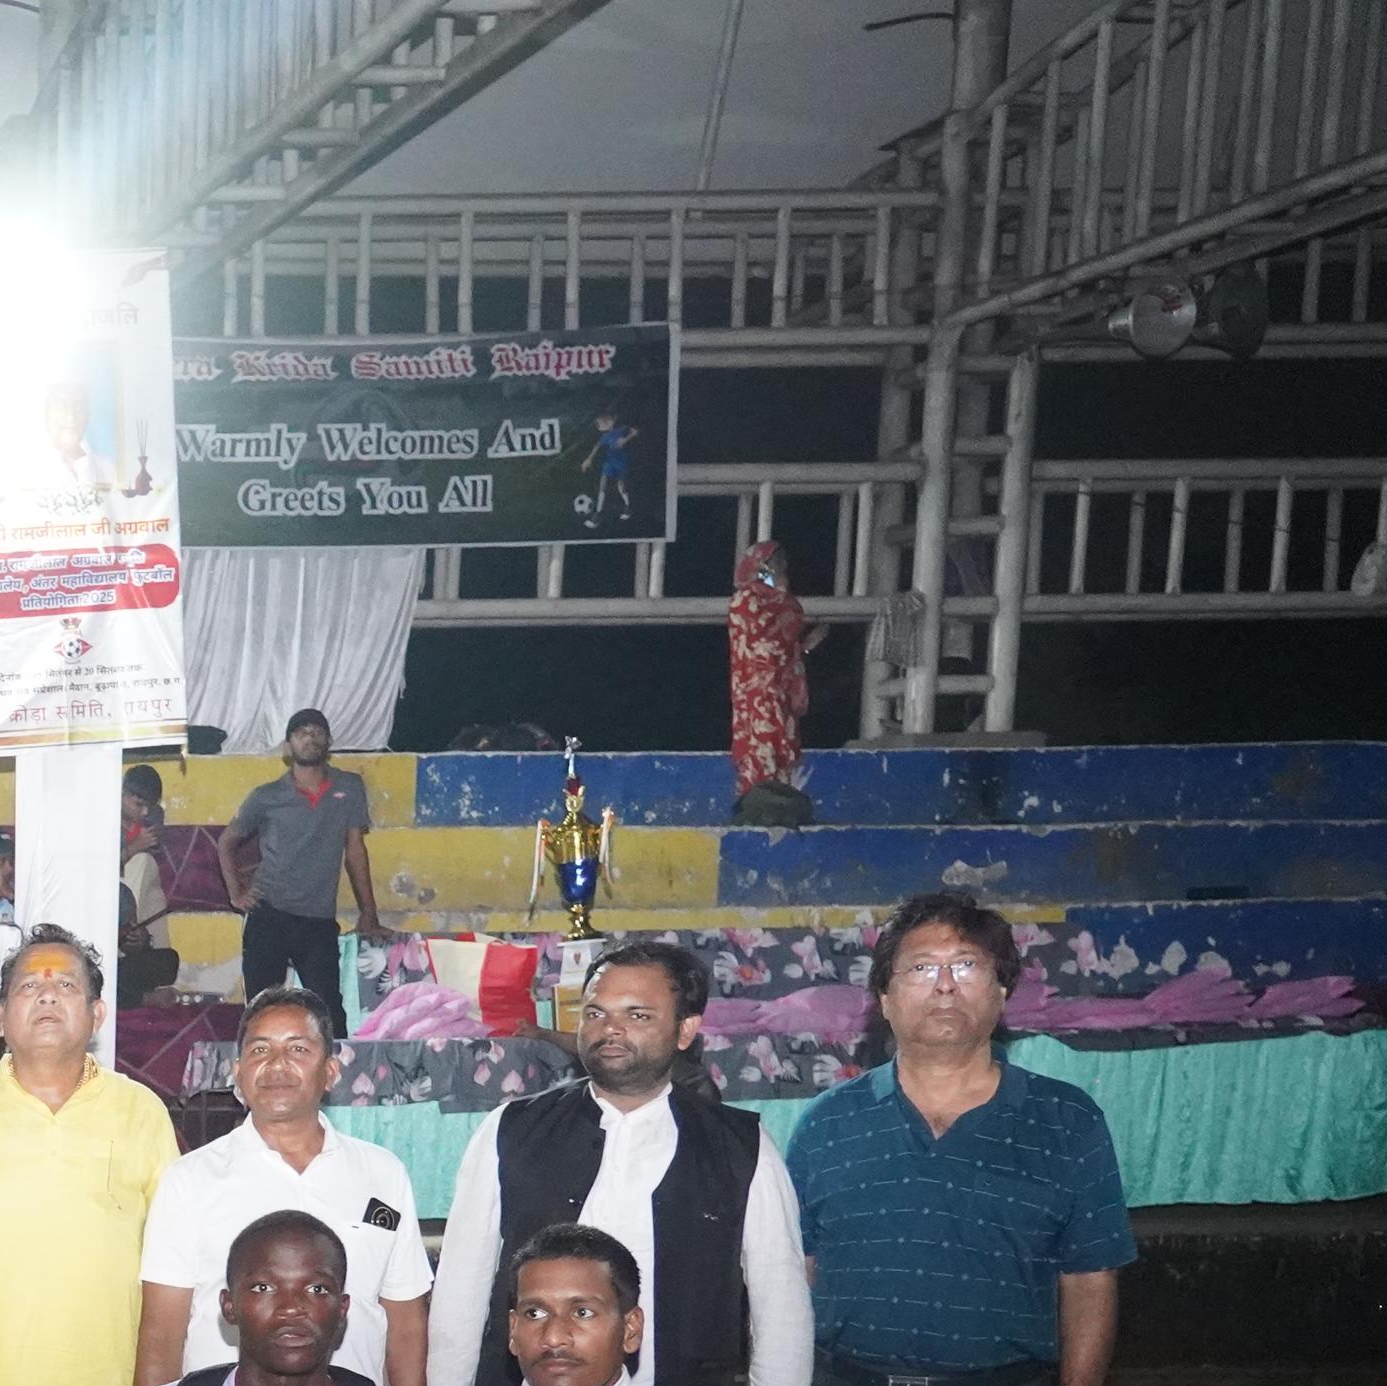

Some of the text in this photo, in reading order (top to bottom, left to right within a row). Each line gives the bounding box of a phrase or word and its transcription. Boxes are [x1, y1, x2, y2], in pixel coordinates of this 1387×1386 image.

[234, 349, 335, 381] Krida
[353, 345, 474, 379] Samiti
[493, 341, 615, 379] Raipur
[177, 421, 560, 467] Warmly Welcomes And
[239, 477, 492, 514] Greets You All
[113, 518, 171, 536] अग्रवाल
